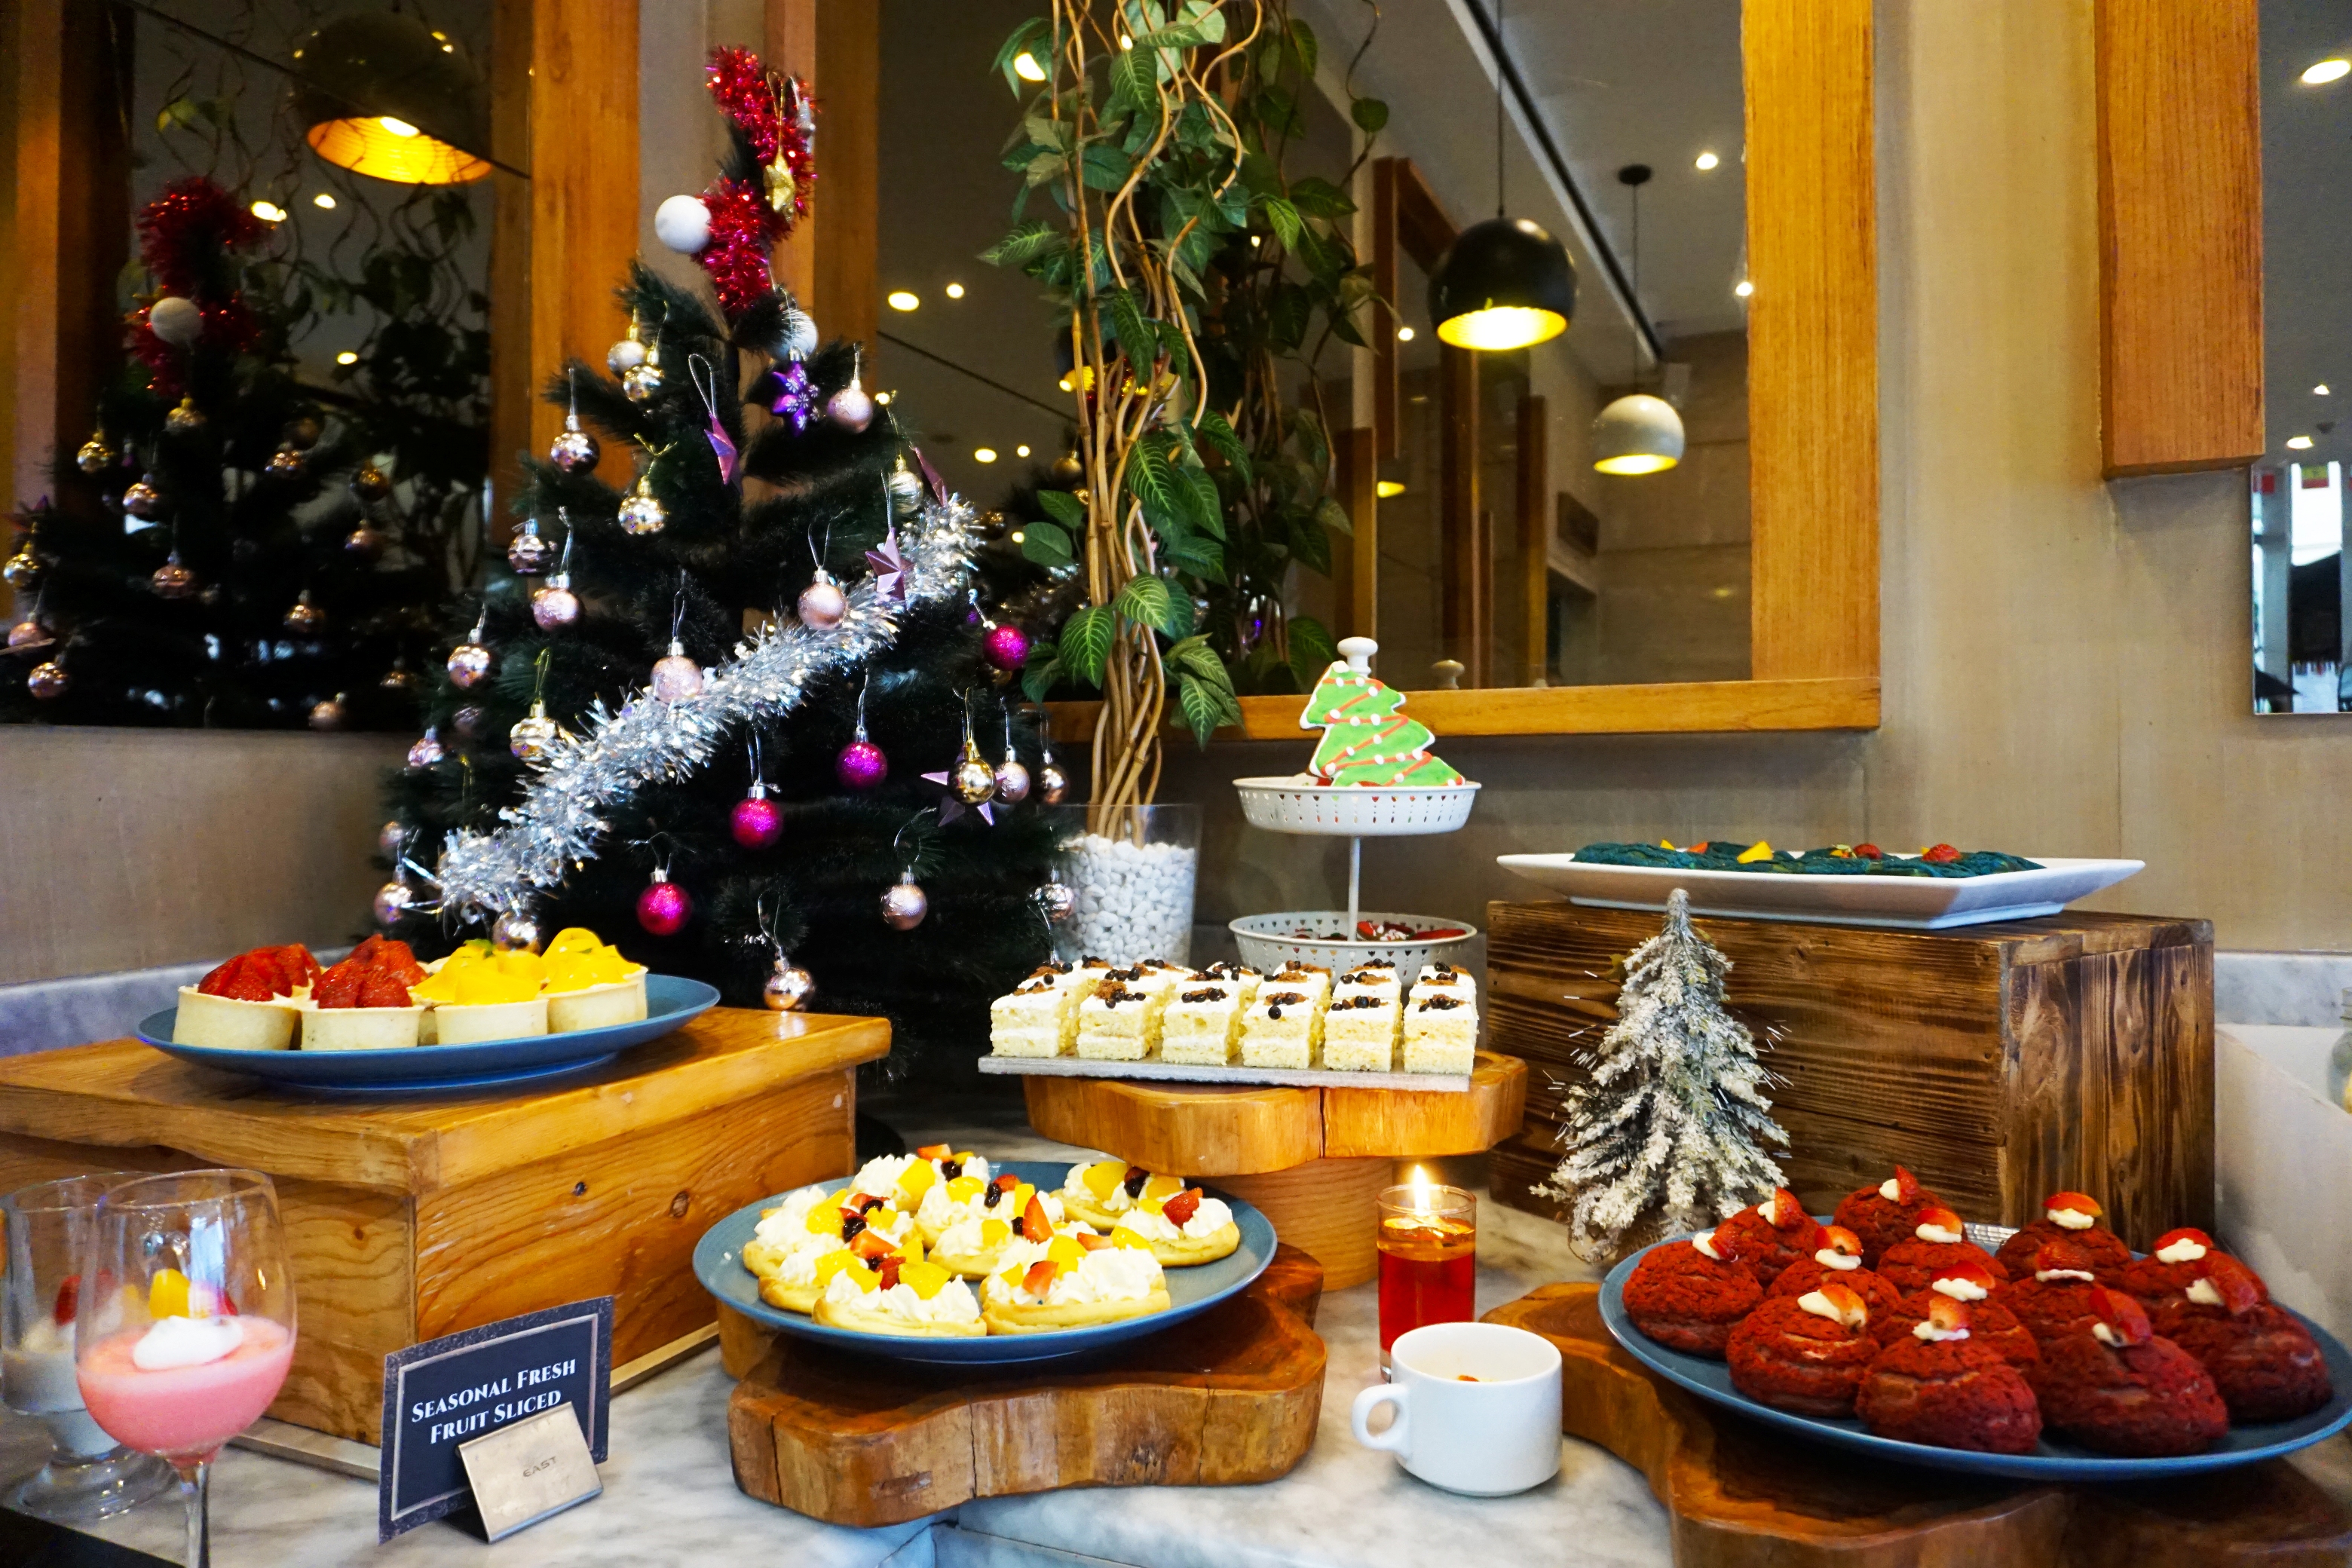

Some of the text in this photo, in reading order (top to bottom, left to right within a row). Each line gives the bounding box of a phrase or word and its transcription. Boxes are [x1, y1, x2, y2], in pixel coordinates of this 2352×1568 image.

[412, 1358, 576, 1423] SEASONAL FRESH
[430, 1389, 562, 1444] FRUIT SLICED
[522, 1456, 556, 1478] EAST
